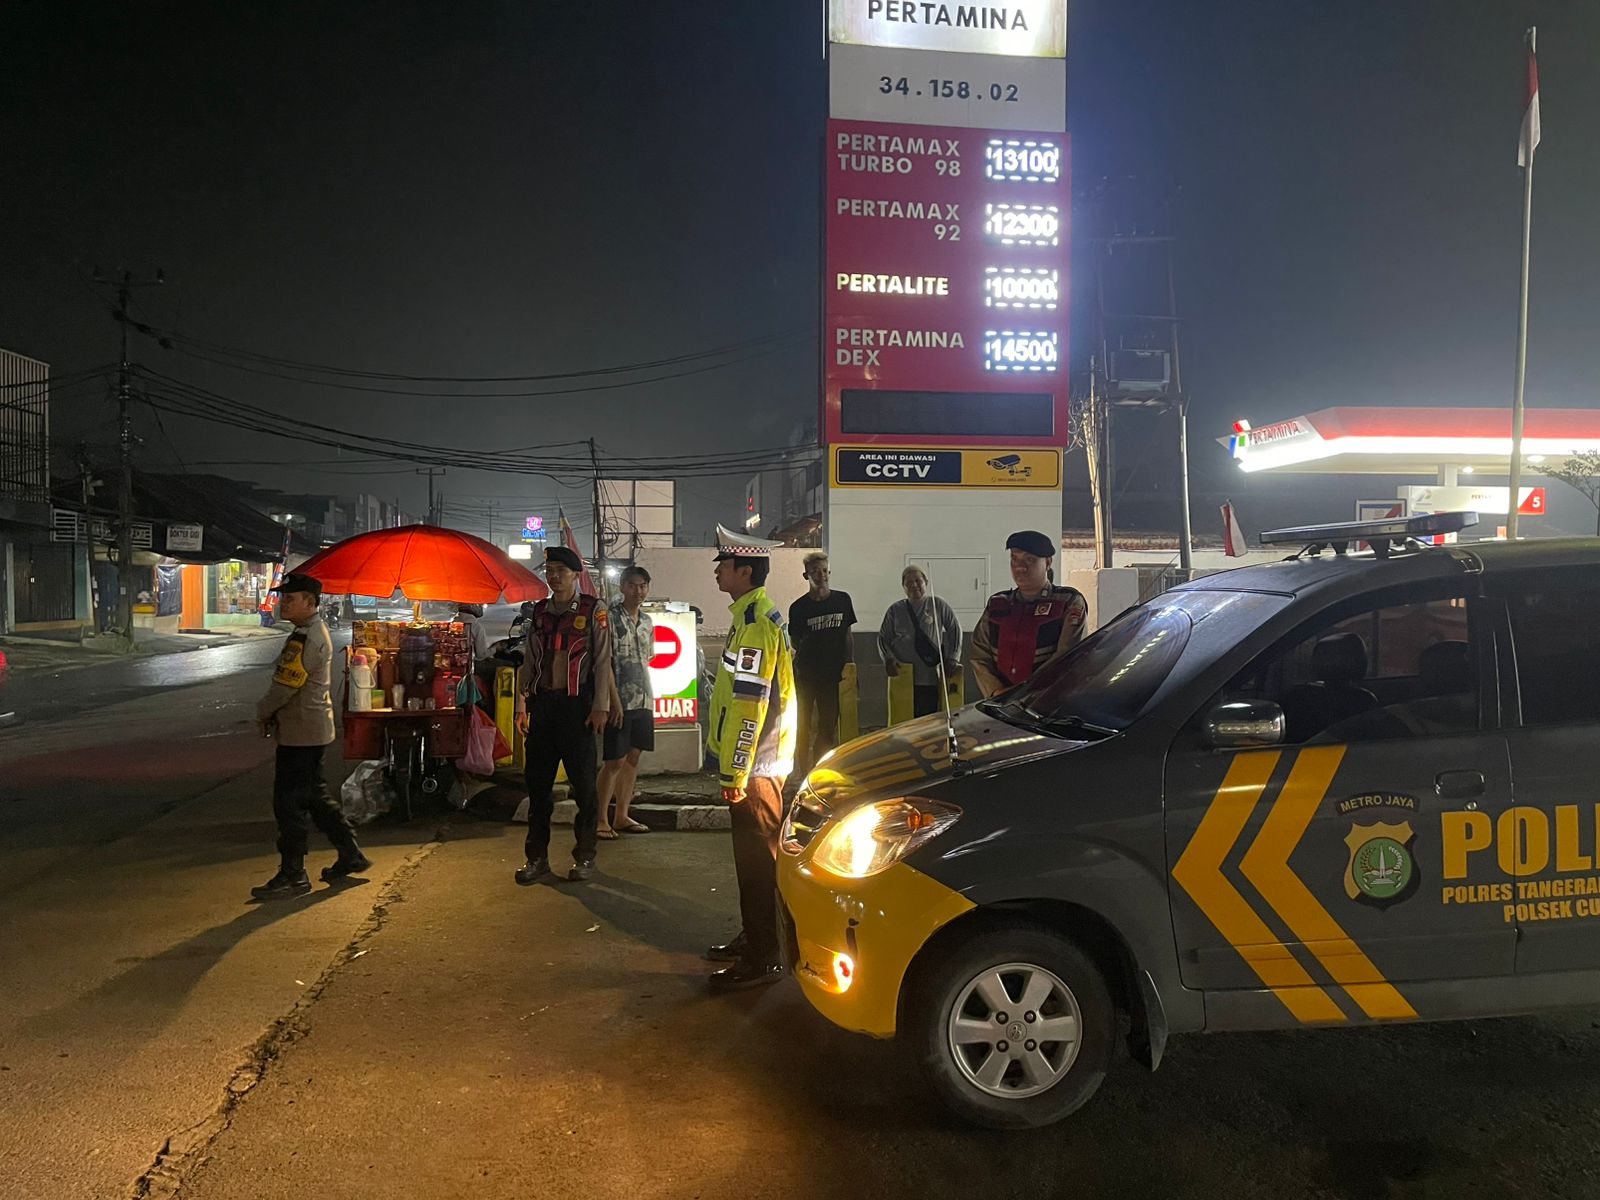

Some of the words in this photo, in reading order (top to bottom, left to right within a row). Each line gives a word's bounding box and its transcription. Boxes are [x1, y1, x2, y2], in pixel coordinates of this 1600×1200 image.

[868, 0, 1029, 31] PERTAMINA
[837, 133, 960, 157] PERTAMAX
[838, 153, 913, 174] TURBO
[935, 160, 961, 177] 98
[992, 148, 1056, 173] 13100
[837, 198, 960, 221] PERTAMAX
[934, 223, 961, 241] 92
[991, 211, 1056, 237] 12300
[836, 273, 949, 296] PERTALITE
[991, 276, 1056, 300] 10000
[836, 328, 965, 349] PERTAMINA
[991, 338, 1056, 362] 14500
[836, 348, 881, 367] DEX
[859, 453, 883, 461] AREA
[899, 454, 936, 462] DIAWASI
[865, 463, 931, 478] CCTV
[1532, 496, 1540, 508] 5
[732, 718, 758, 770] POLISI
[1340, 795, 1383, 812] METRO
[1385, 795, 1414, 809] JAYA
[1441, 802, 1600, 880] POL
[1442, 883, 1513, 904] POLRES
[1517, 877, 1600, 900] TANGERA
[1503, 900, 1573, 922] POLSEK
